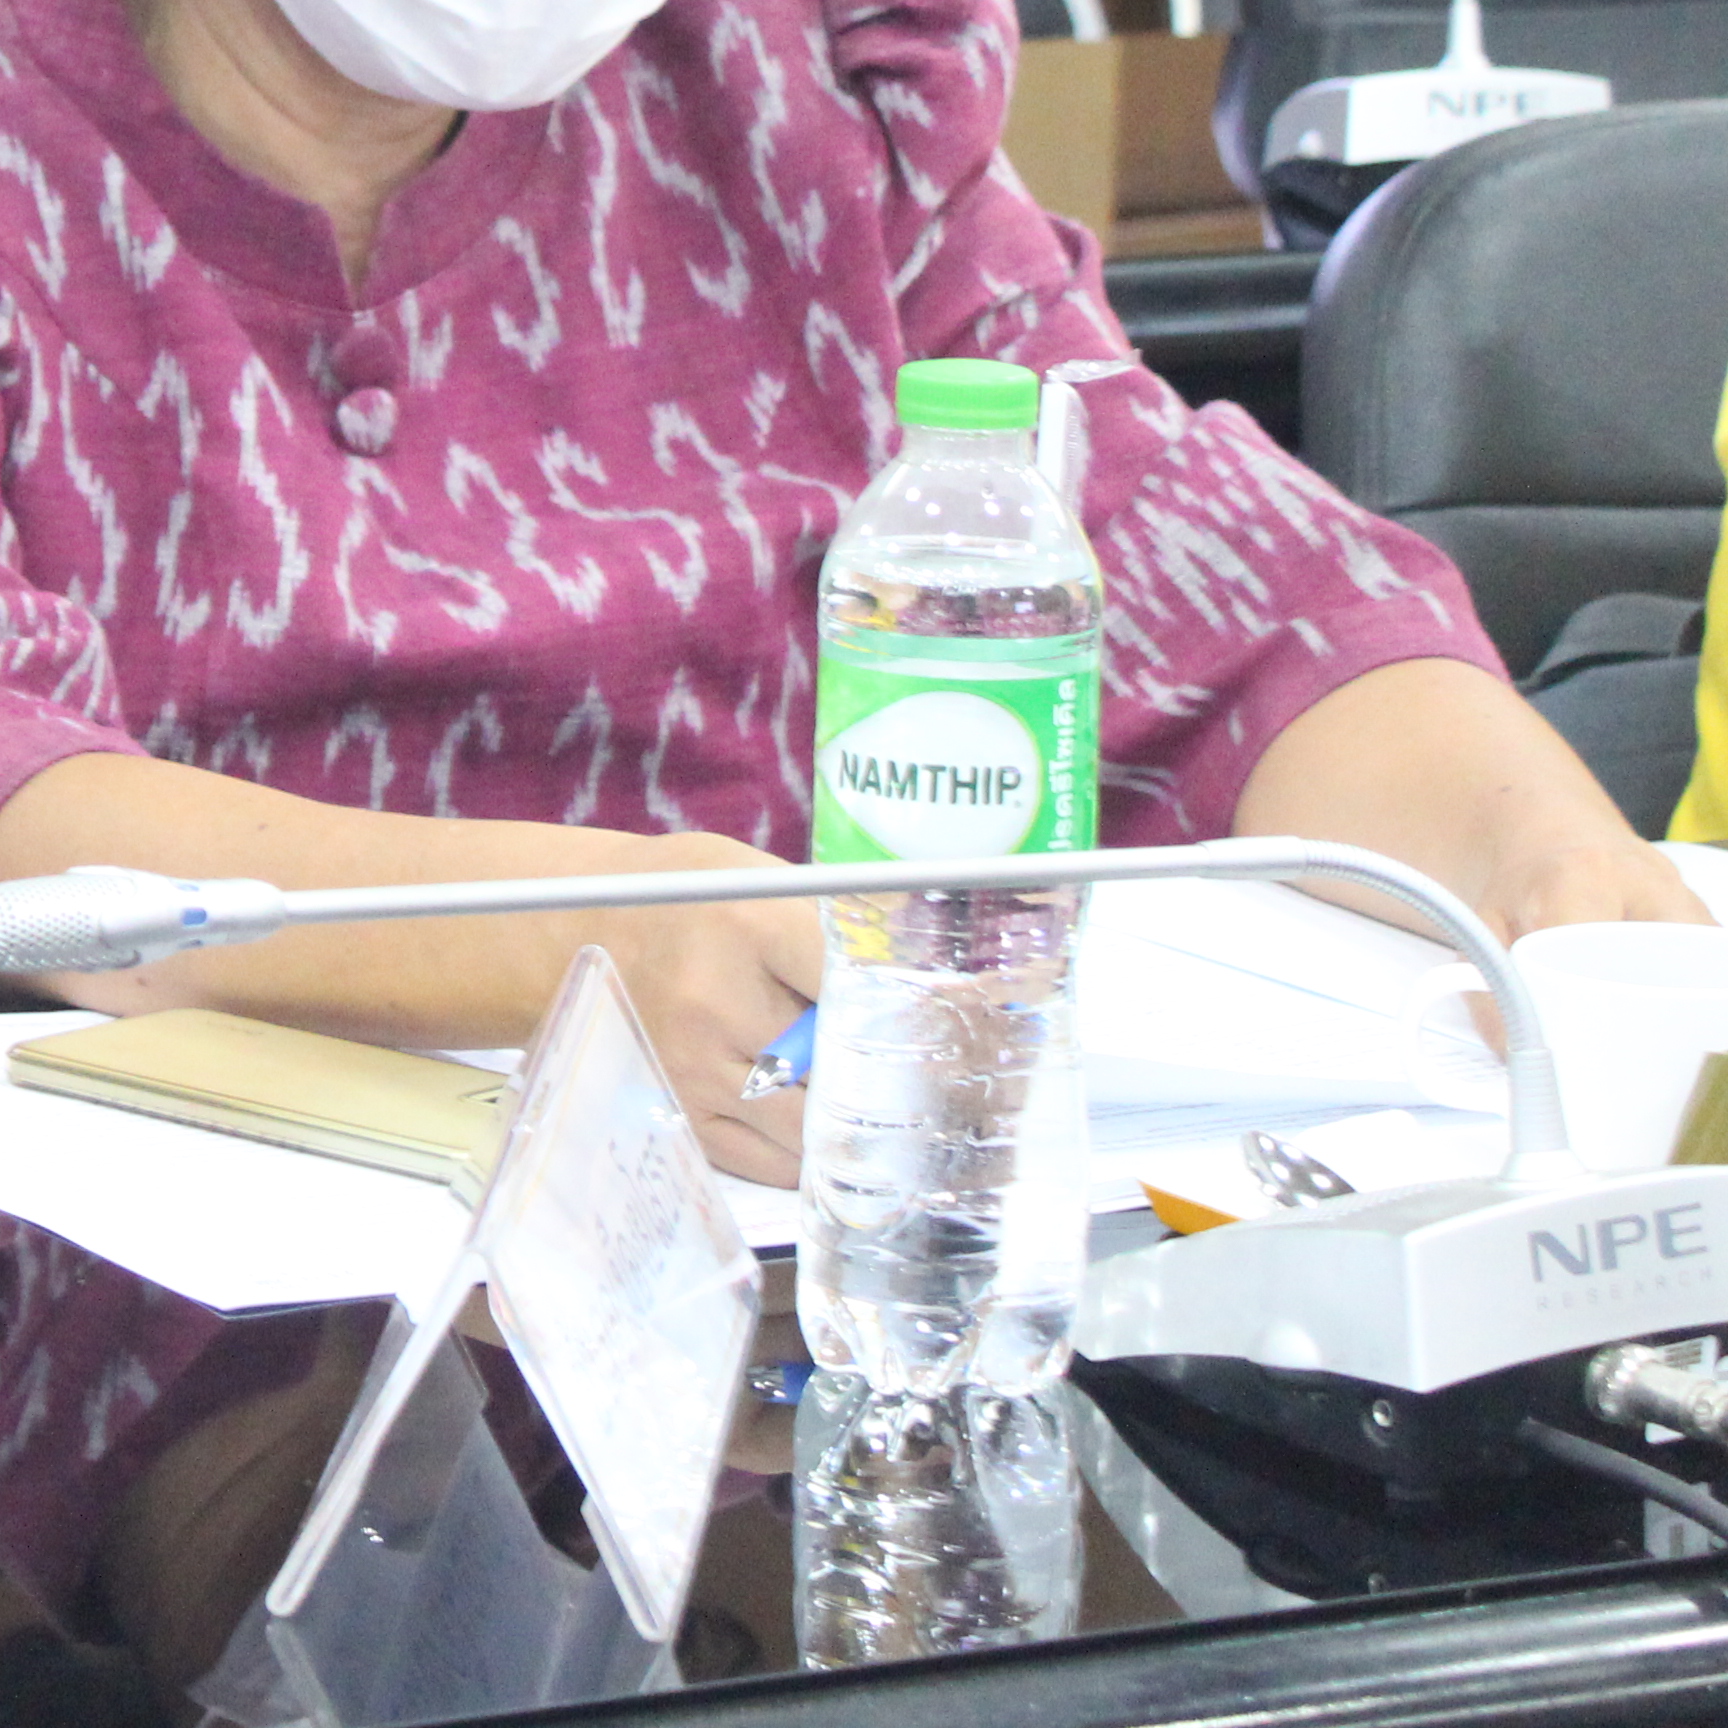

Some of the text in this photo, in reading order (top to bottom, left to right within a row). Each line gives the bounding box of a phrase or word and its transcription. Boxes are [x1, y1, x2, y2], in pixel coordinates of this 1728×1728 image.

[1427, 89, 1547, 119] NPE
[839, 749, 1021, 805] NAMTHIP
[1527, 1202, 1709, 1283] NPE
[1536, 1266, 1713, 1311] RESEARCH
